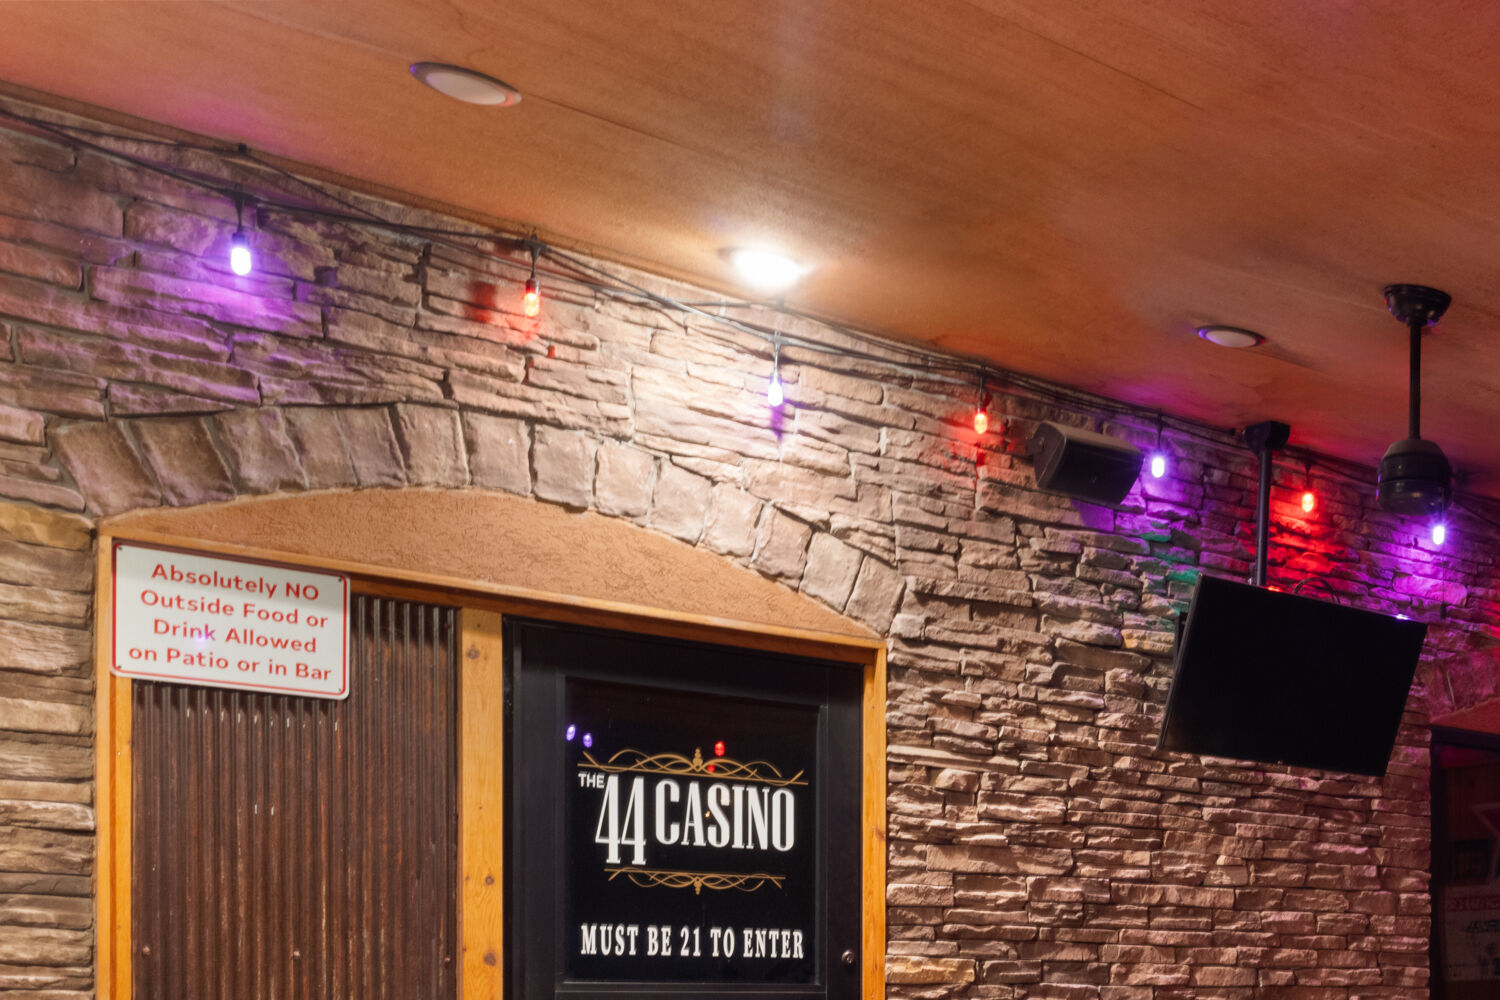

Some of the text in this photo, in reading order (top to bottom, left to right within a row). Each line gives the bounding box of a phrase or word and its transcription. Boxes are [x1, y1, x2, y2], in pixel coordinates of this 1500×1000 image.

[151, 563, 319, 601] Absolutely NO
[140, 589, 328, 629] Outside Food or
[153, 618, 317, 653] Drink Allowed
[129, 647, 332, 681] on Patio or in Bar
[577, 770, 605, 789] THE
[595, 774, 795, 865] 44 CASINO
[580, 923, 804, 959] MUST BE 21 TO ENTER
